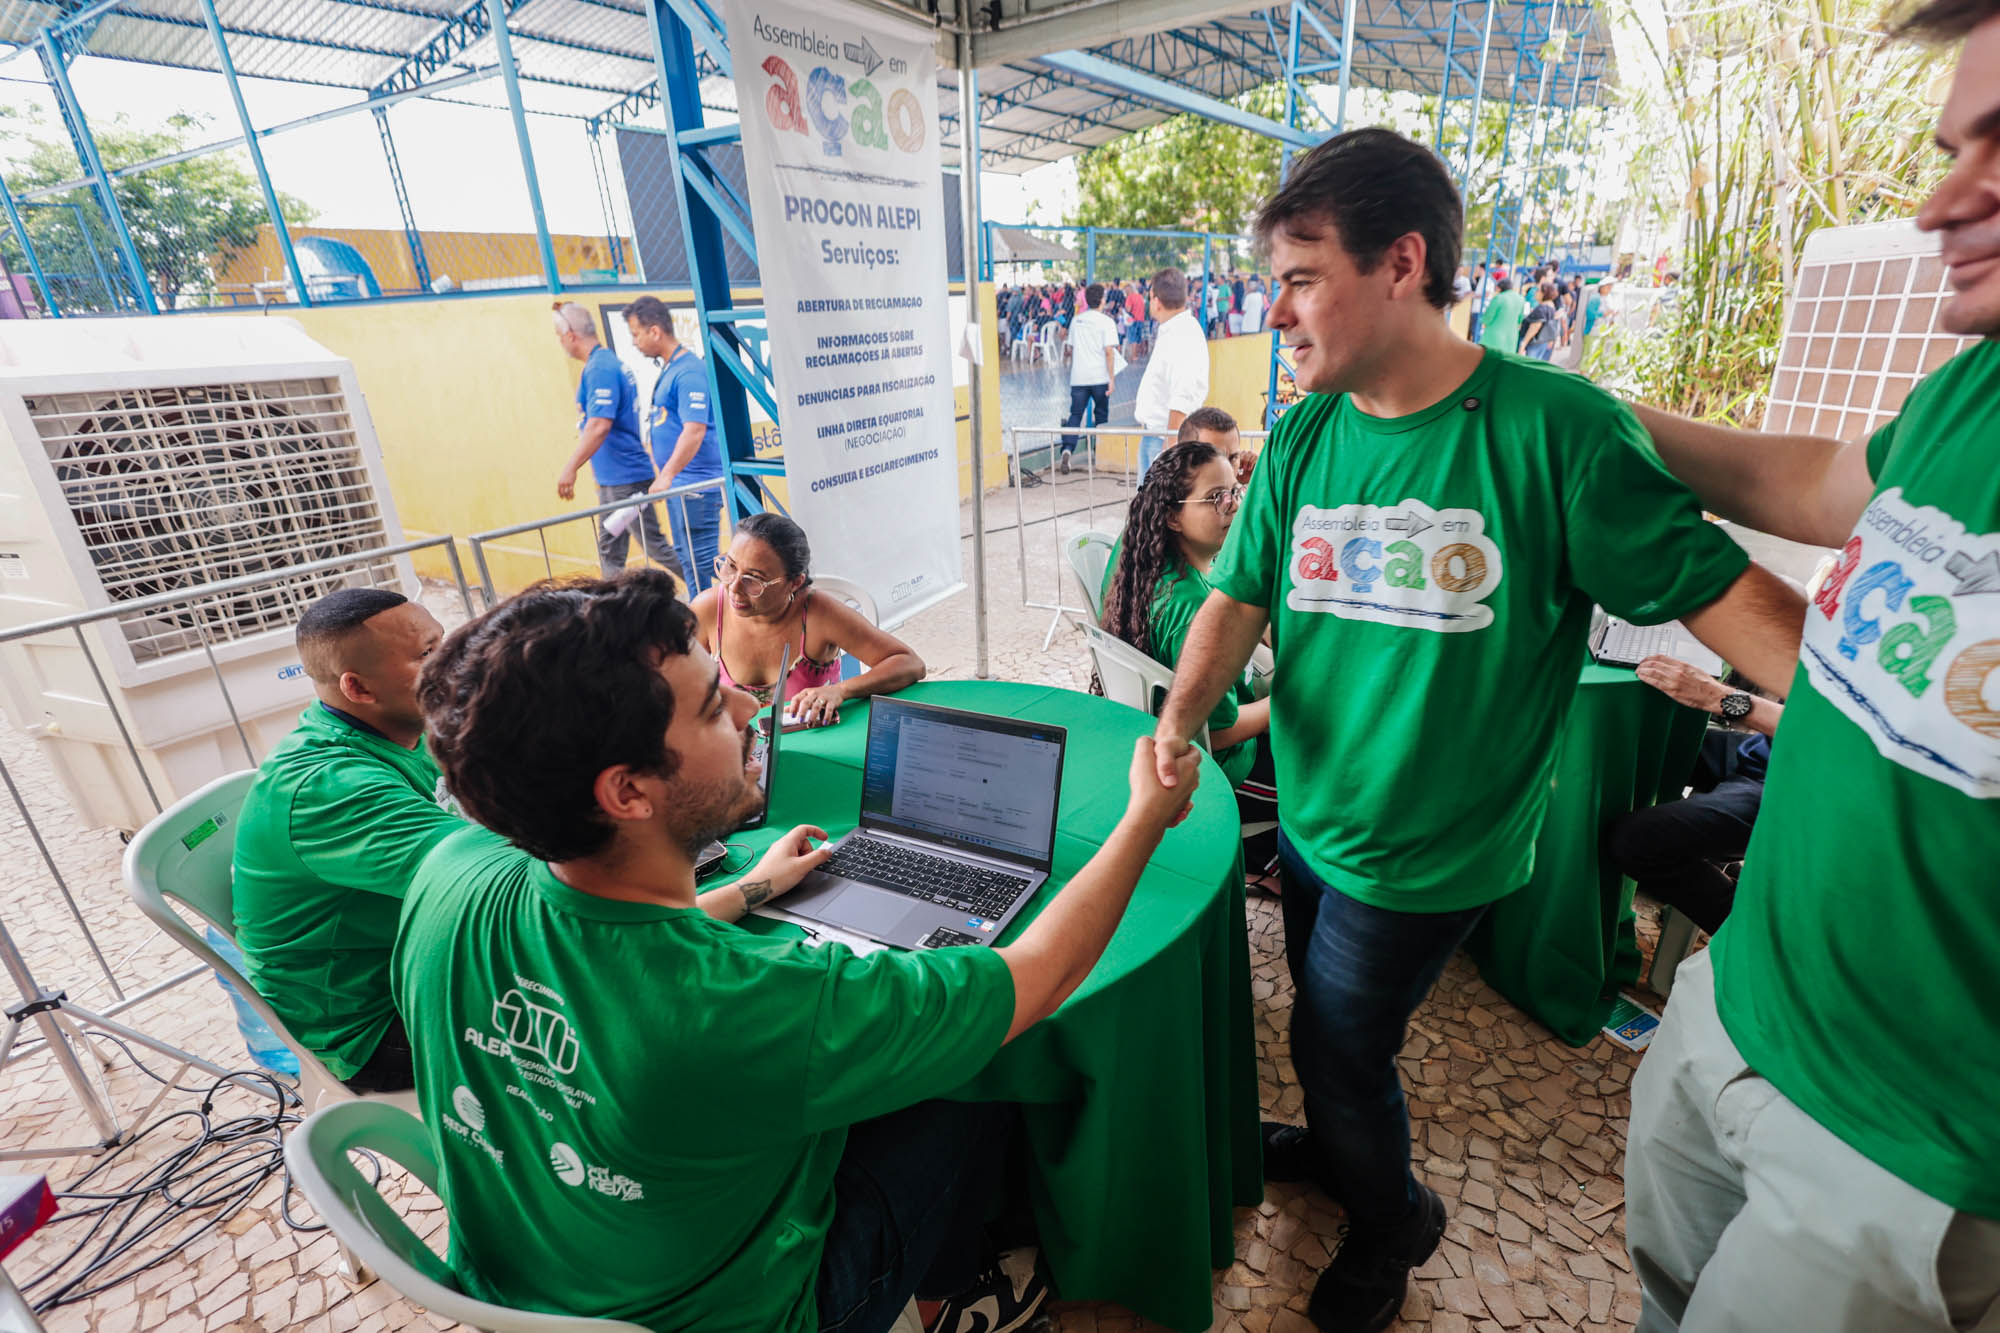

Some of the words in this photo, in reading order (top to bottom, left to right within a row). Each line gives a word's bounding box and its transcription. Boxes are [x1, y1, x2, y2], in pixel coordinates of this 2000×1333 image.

[753, 14, 839, 60] Assembleia
[889, 57, 908, 74] em
[784, 195, 873, 228] PROCON
[876, 204, 922, 231] ALEPI
[821, 239, 900, 270] Serviços:
[797, 299, 851, 313] ABERTURA
[853, 299, 865, 311] DE
[889, 329, 915, 343] SOBRE
[891, 344, 924, 359] ABERTAS
[857, 383, 881, 398] PARA
[817, 423, 846, 439] LINHA
[846, 416, 877, 433] DIRETA
[810, 470, 858, 493] CONSULTA
[859, 467, 865, 480] E
[1302, 515, 1380, 532] Assembleia
[1441, 519, 1471, 533] em
